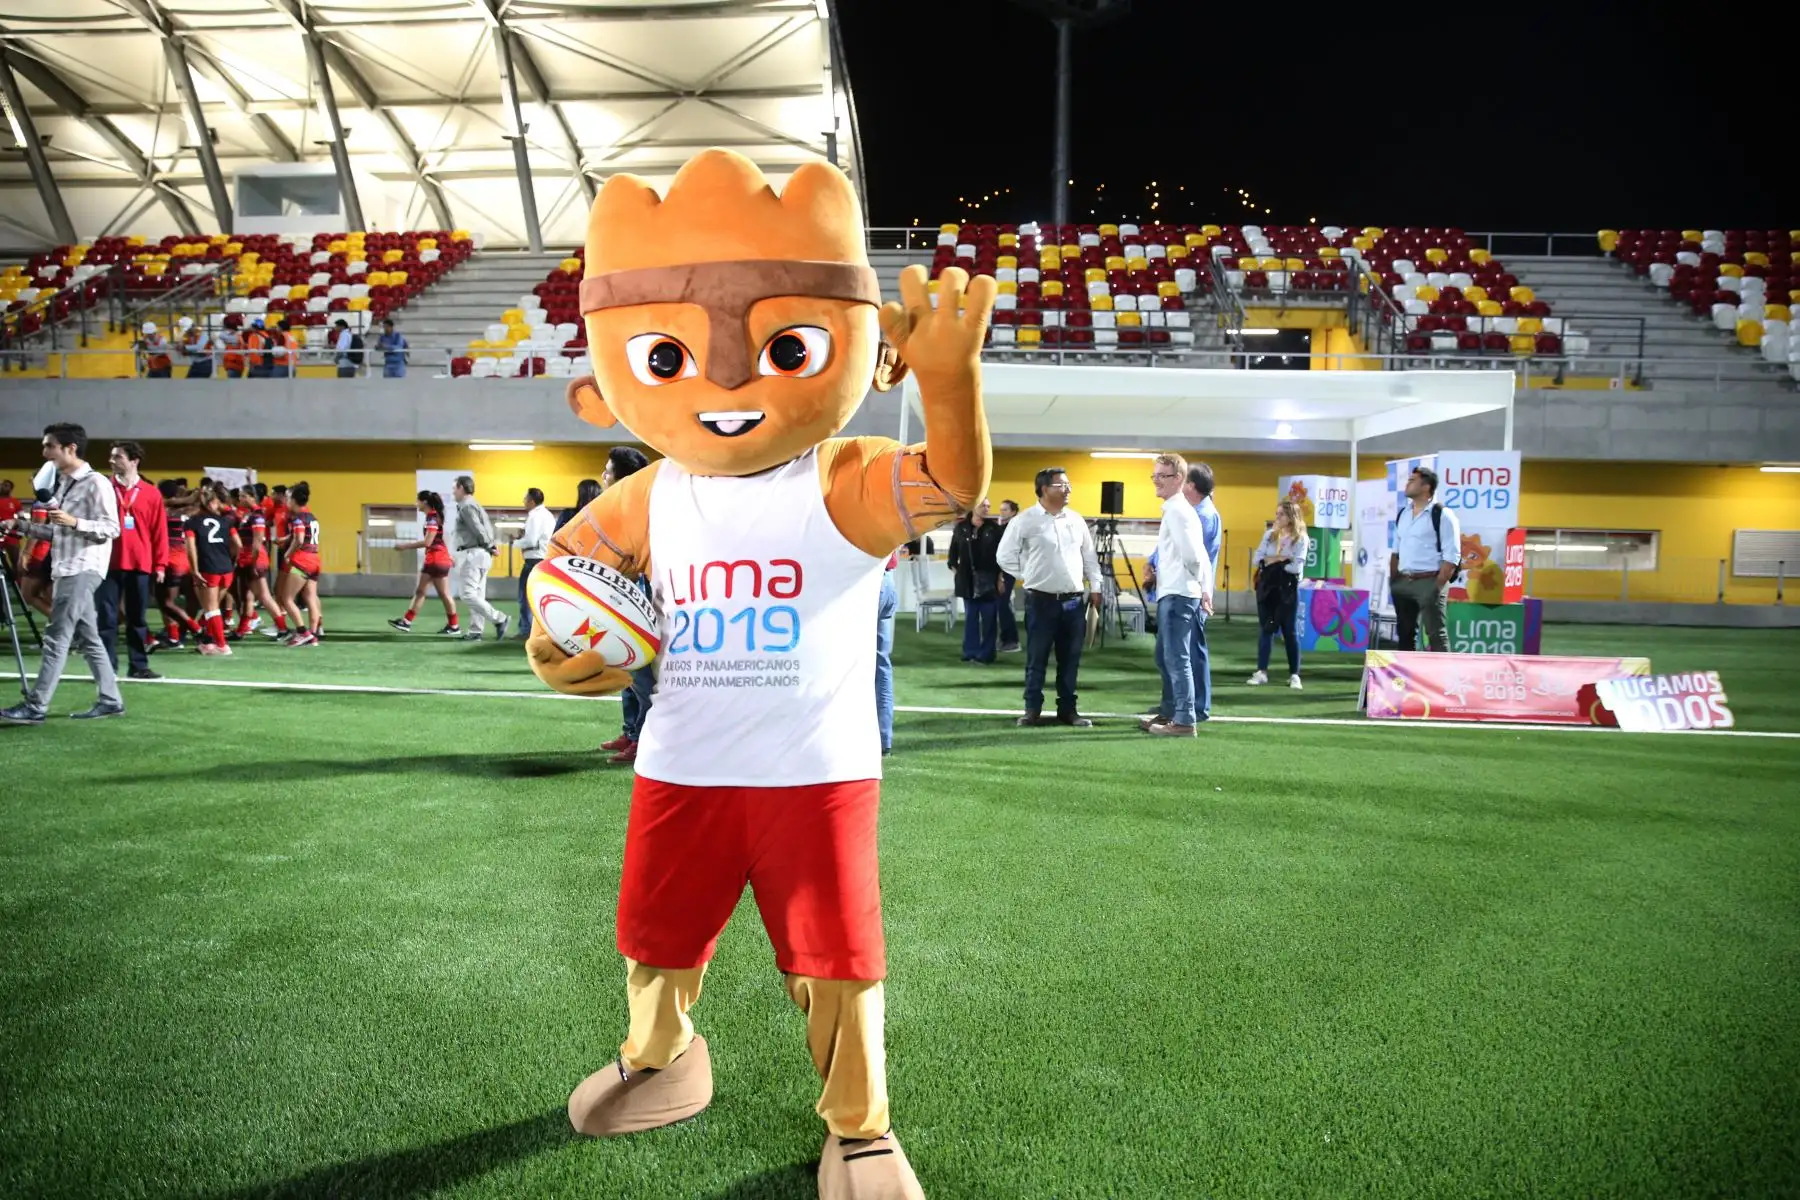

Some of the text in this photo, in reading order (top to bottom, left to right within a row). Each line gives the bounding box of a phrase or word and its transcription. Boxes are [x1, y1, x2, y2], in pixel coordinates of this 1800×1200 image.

[1444, 488, 1510, 509] 2019
[1318, 502, 1347, 517] 2019
[203, 518, 224, 543] 2
[567, 557, 658, 627] GILBERT
[668, 605, 801, 655] 2019
[1454, 641, 1516, 655] 2019
[696, 659, 801, 671] PANAMERICANOS
[670, 675, 801, 688] PARAPANAMERICANOS
[1600, 671, 1722, 699] UGAMOS
[1484, 684, 1528, 701] 2019
[1606, 693, 1734, 733] ODOS
